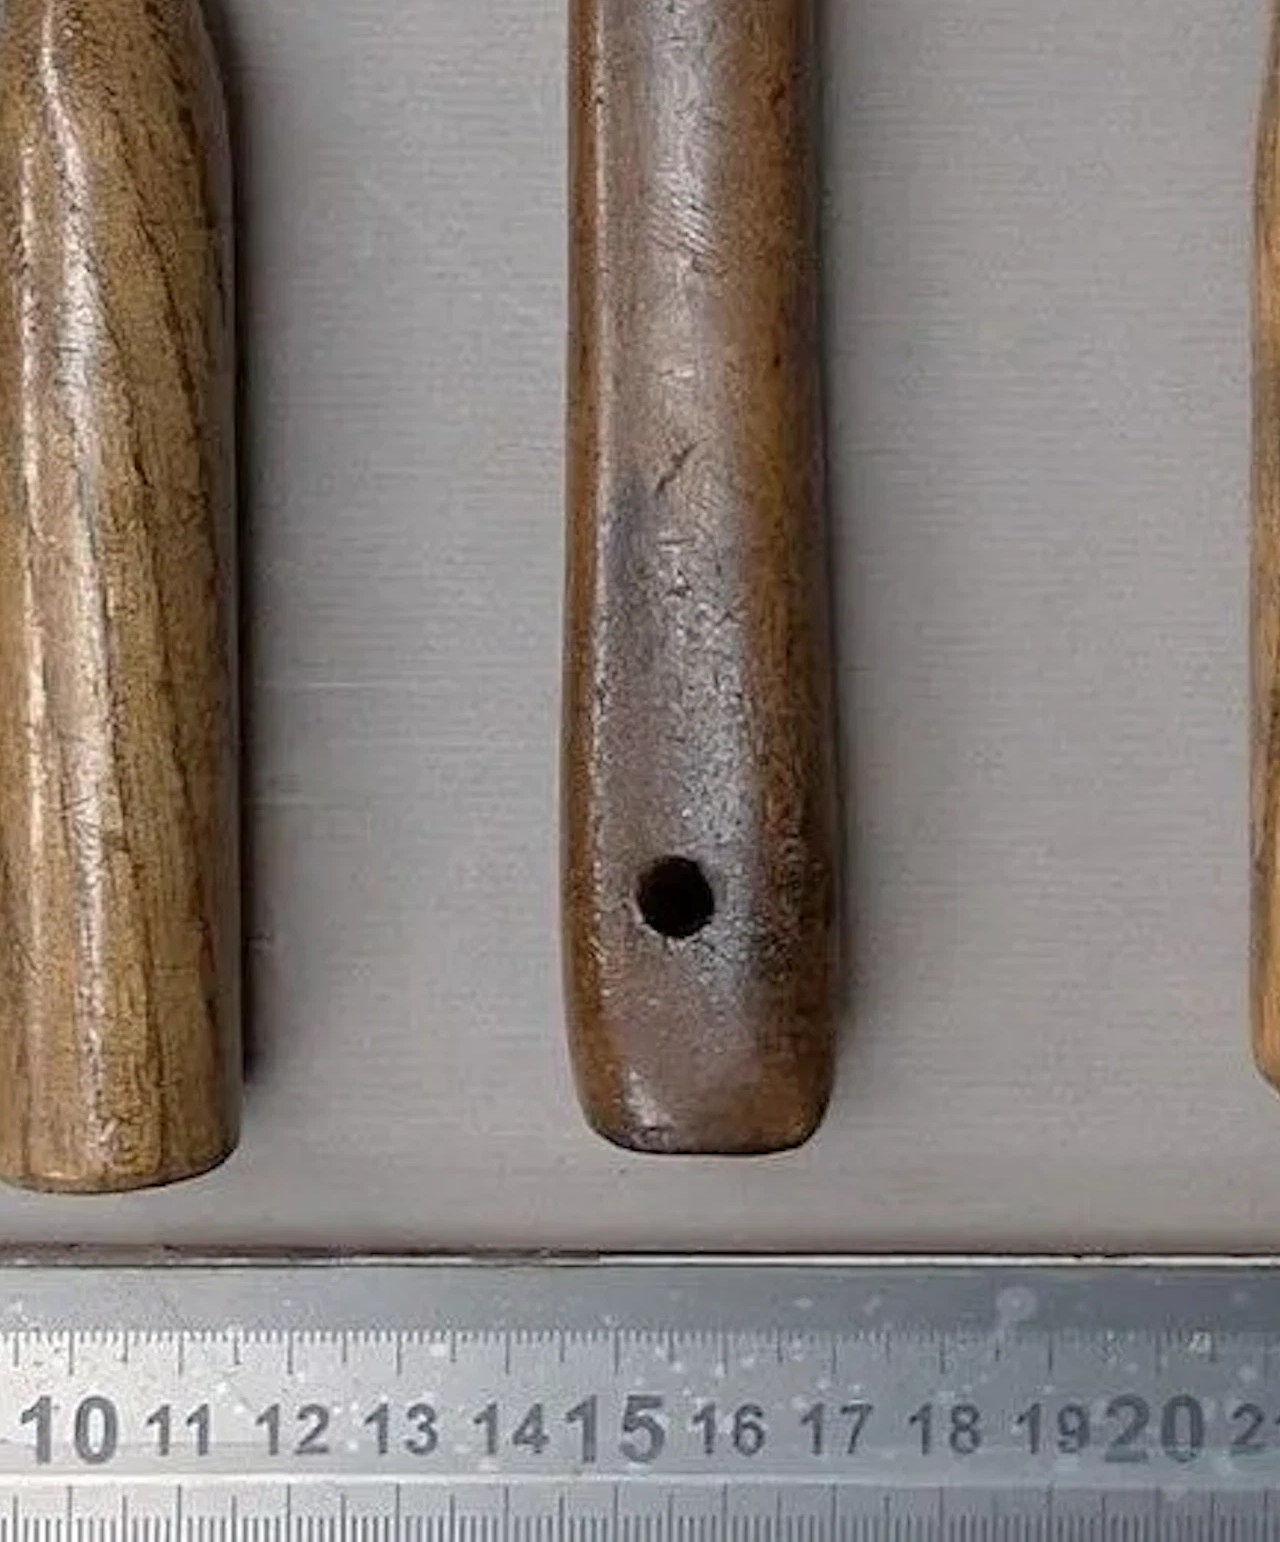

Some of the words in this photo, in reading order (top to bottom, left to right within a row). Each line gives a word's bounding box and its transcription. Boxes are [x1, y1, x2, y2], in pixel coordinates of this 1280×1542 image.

[21, 1395, 117, 1464] 10
[146, 1404, 211, 1456] 11
[256, 1403, 330, 1455] 12
[365, 1403, 439, 1455] 13
[473, 1403, 549, 1455] 14
[566, 1394, 664, 1463] 15
[692, 1403, 766, 1455] 16
[800, 1403, 873, 1455] 17
[908, 1403, 981, 1455] 18
[1017, 1403, 1089, 1455] 19
[1105, 1394, 1205, 1463] 20
